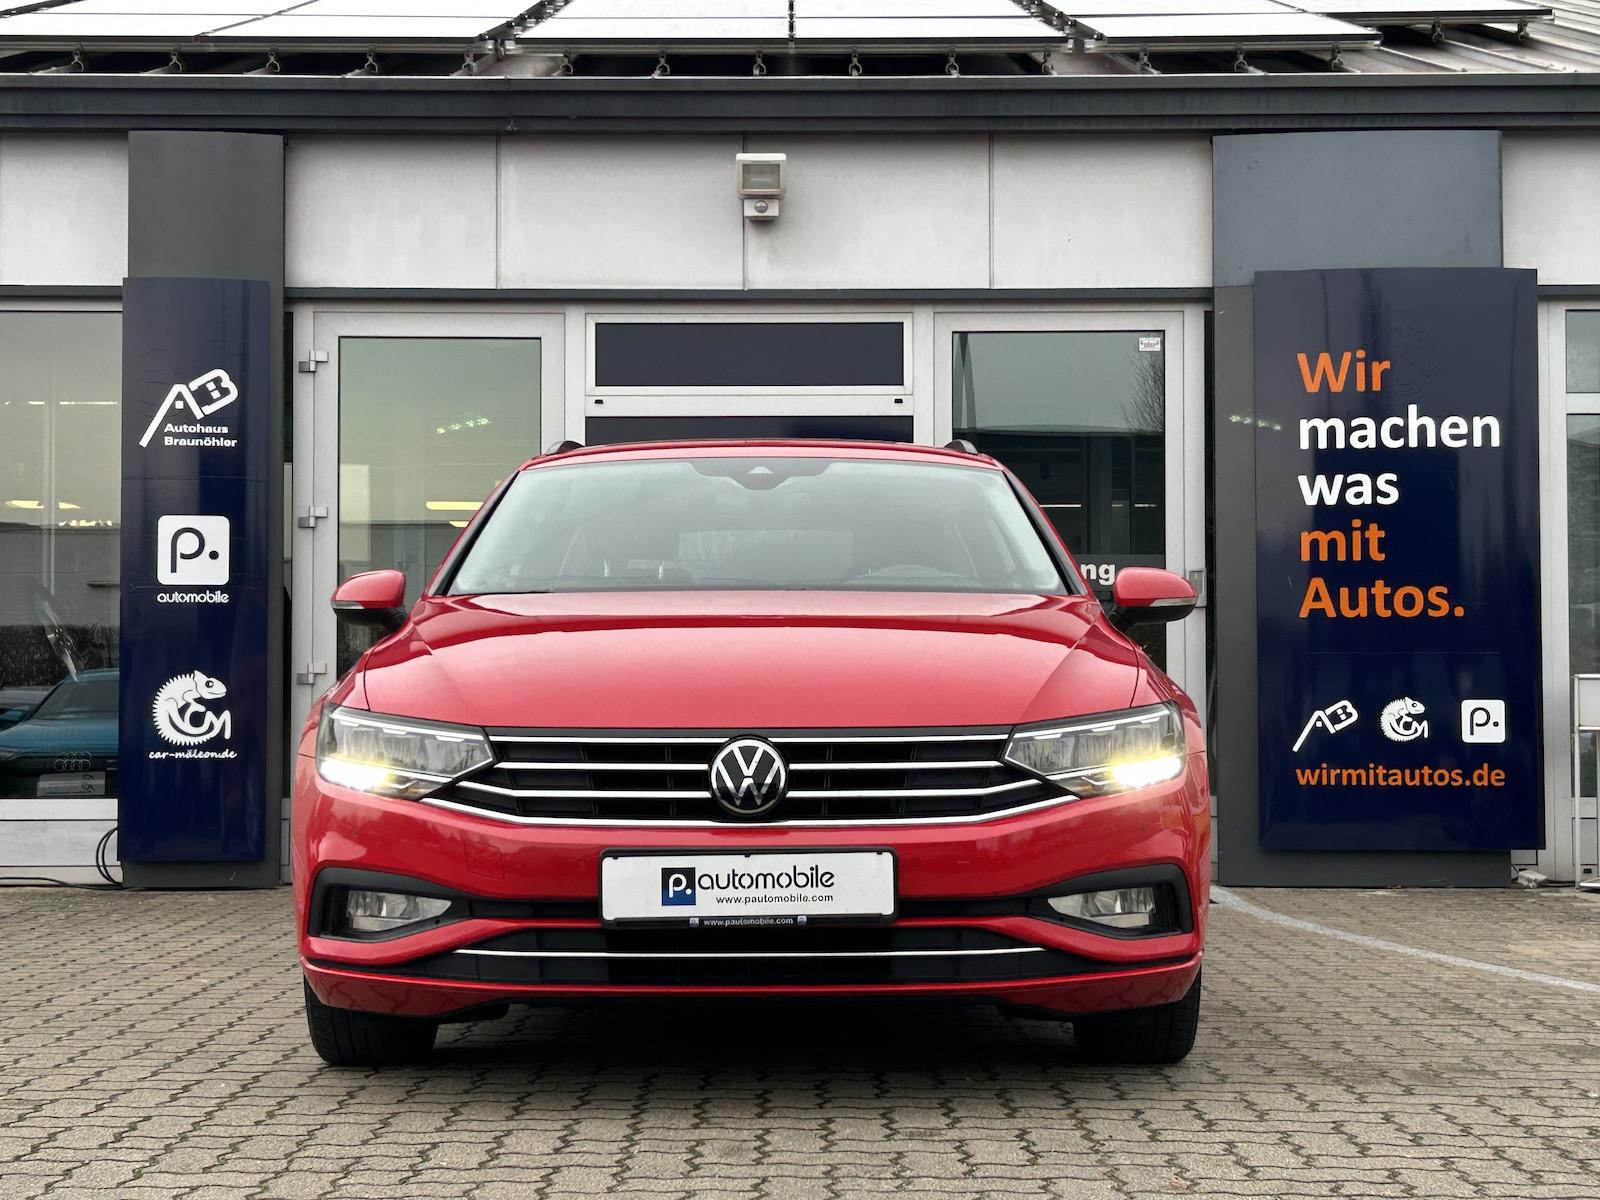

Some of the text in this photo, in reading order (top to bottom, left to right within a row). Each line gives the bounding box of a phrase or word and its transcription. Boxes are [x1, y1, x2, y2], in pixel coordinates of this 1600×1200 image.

[1296, 350, 1391, 393] Wir
[163, 422, 229, 434] Autohaus
[1299, 404, 1501, 450] machen
[163, 435, 238, 447] Braunöhler
[1297, 472, 1400, 506] was
[1299, 518, 1386, 562] mit
[156, 589, 230, 604] automobile
[1298, 576, 1465, 619] Autos.
[1295, 762, 1506, 787] wirmitautos.de
[697, 864, 836, 891] automobile
[715, 893, 834, 906] www.pautomobile.com
[703, 916, 794, 927] www.pautomobile.com
